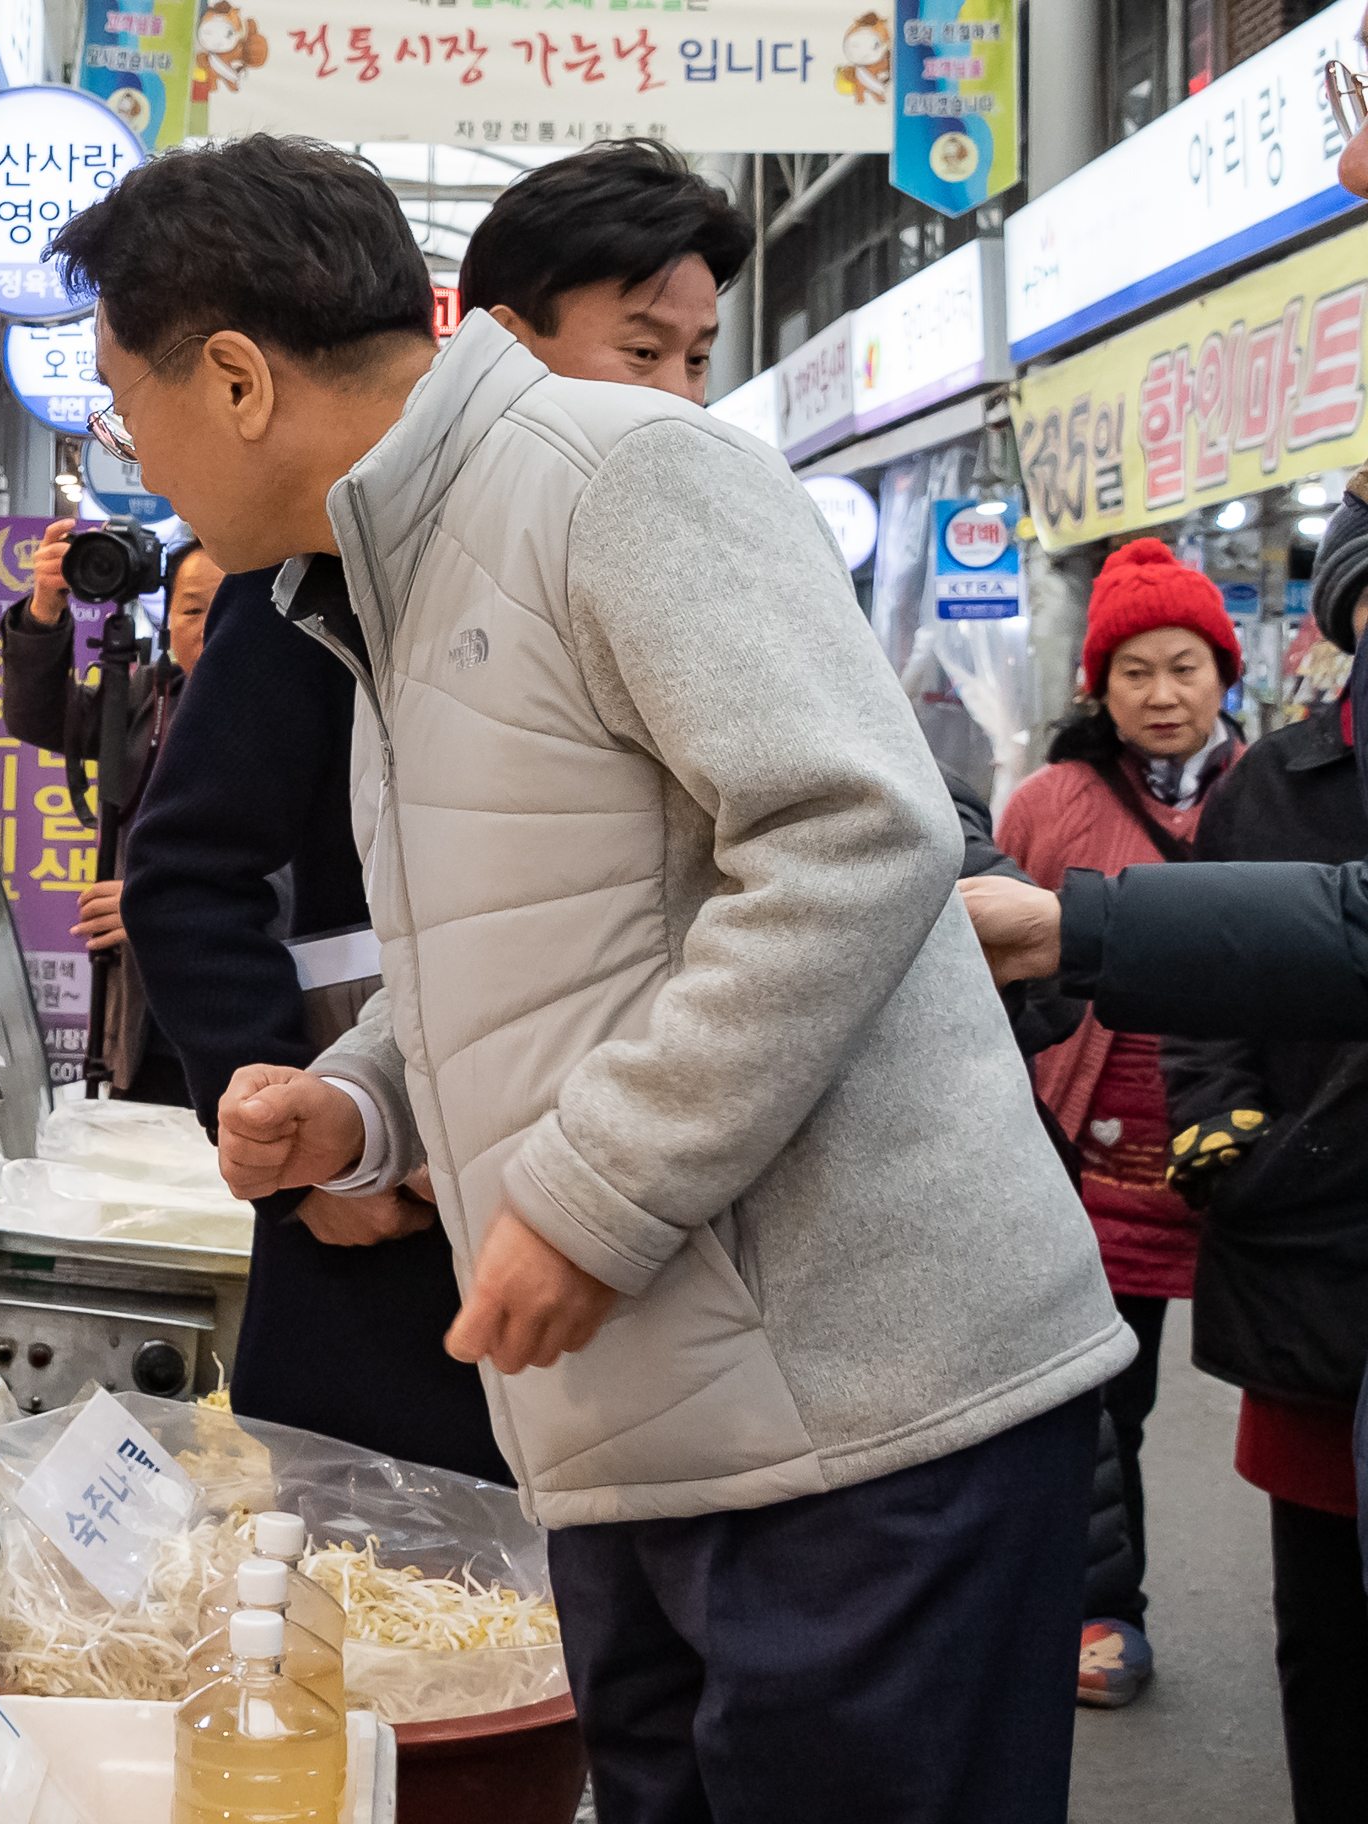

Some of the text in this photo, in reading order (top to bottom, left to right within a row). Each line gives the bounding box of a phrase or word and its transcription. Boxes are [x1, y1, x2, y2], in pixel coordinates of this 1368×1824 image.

[288, 24, 814, 93] 전통시장 가는날 입니다
[1188, 74, 1286, 207] 아리랑
[1138, 275, 1368, 512] 할인마트
[952, 521, 1001, 546] 담배
[65, 1437, 161, 1548] 숙주나물
